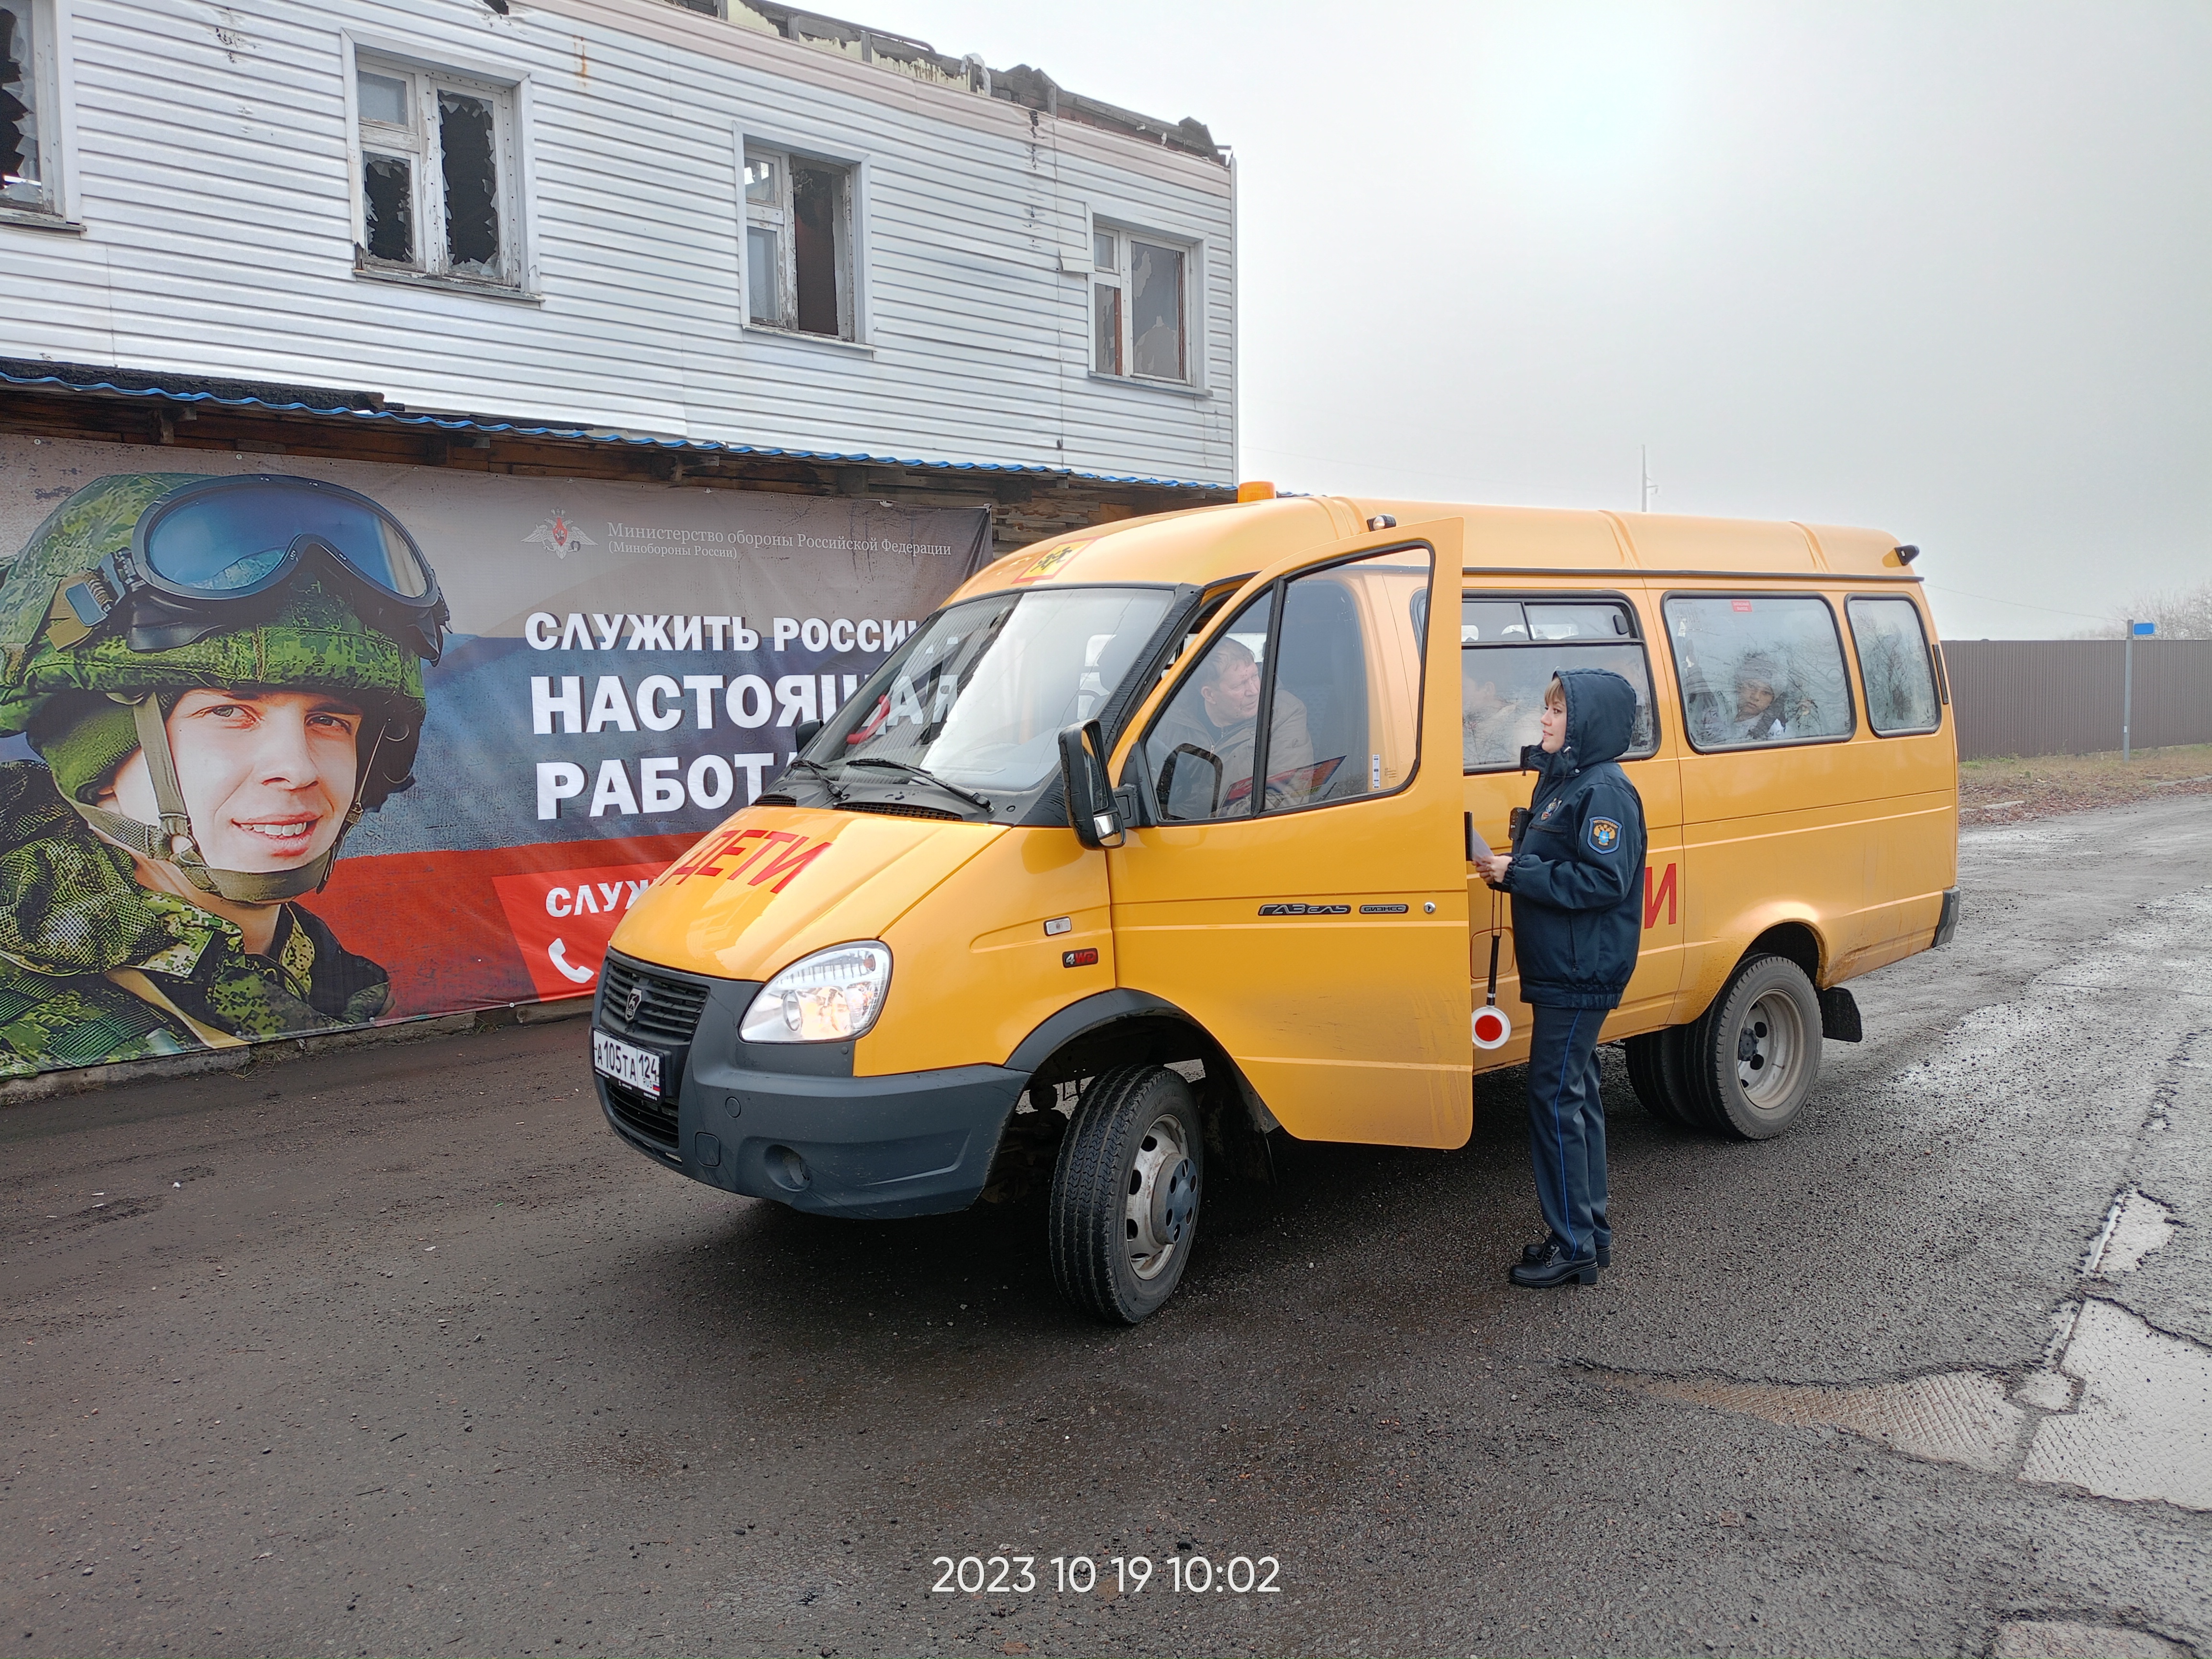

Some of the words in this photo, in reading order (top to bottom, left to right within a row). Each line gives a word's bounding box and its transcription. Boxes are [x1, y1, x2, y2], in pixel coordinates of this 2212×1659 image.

[607, 522, 724, 544] Министерство
[727, 530, 794, 549] обороны
[797, 529, 878, 551] Российской
[881, 538, 951, 557] Федерации
[608, 541, 691, 557] (Минобороны
[694, 546, 737, 560] России)
[525, 612, 761, 651] СЛУЖИТЬ
[536, 752, 797, 820] РАБОТ
[659, 830, 833, 894] ДЕТИ
[1066, 951, 1097, 965] 4WD
[639, 1054, 659, 1081] 124
[642, 1077, 653, 1088] RUS
